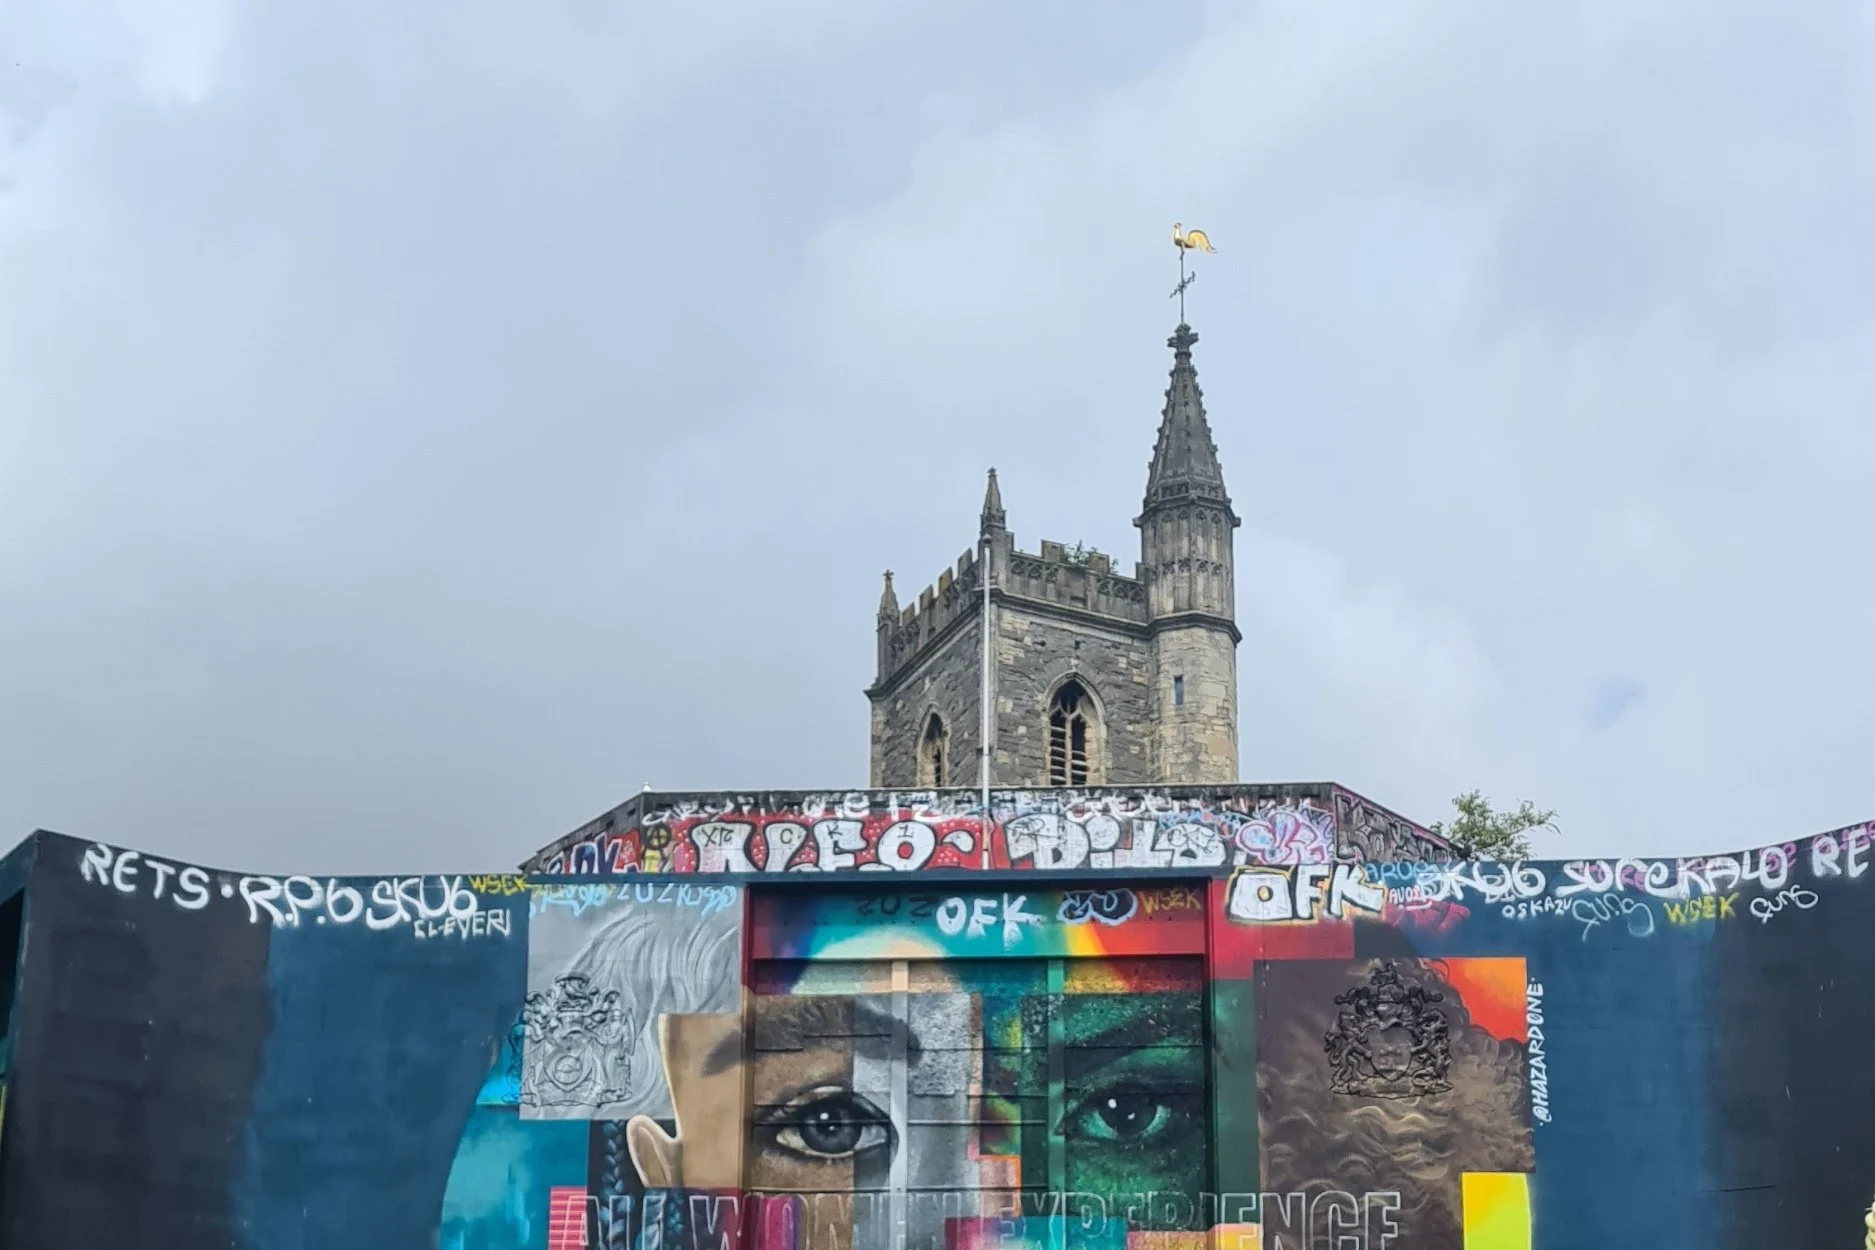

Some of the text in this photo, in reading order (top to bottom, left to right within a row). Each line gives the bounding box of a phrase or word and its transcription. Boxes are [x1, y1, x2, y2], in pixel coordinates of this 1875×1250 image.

[80, 842, 210, 910] RETS
[1228, 864, 1388, 925] OFK
[936, 892, 1044, 947] OFK
